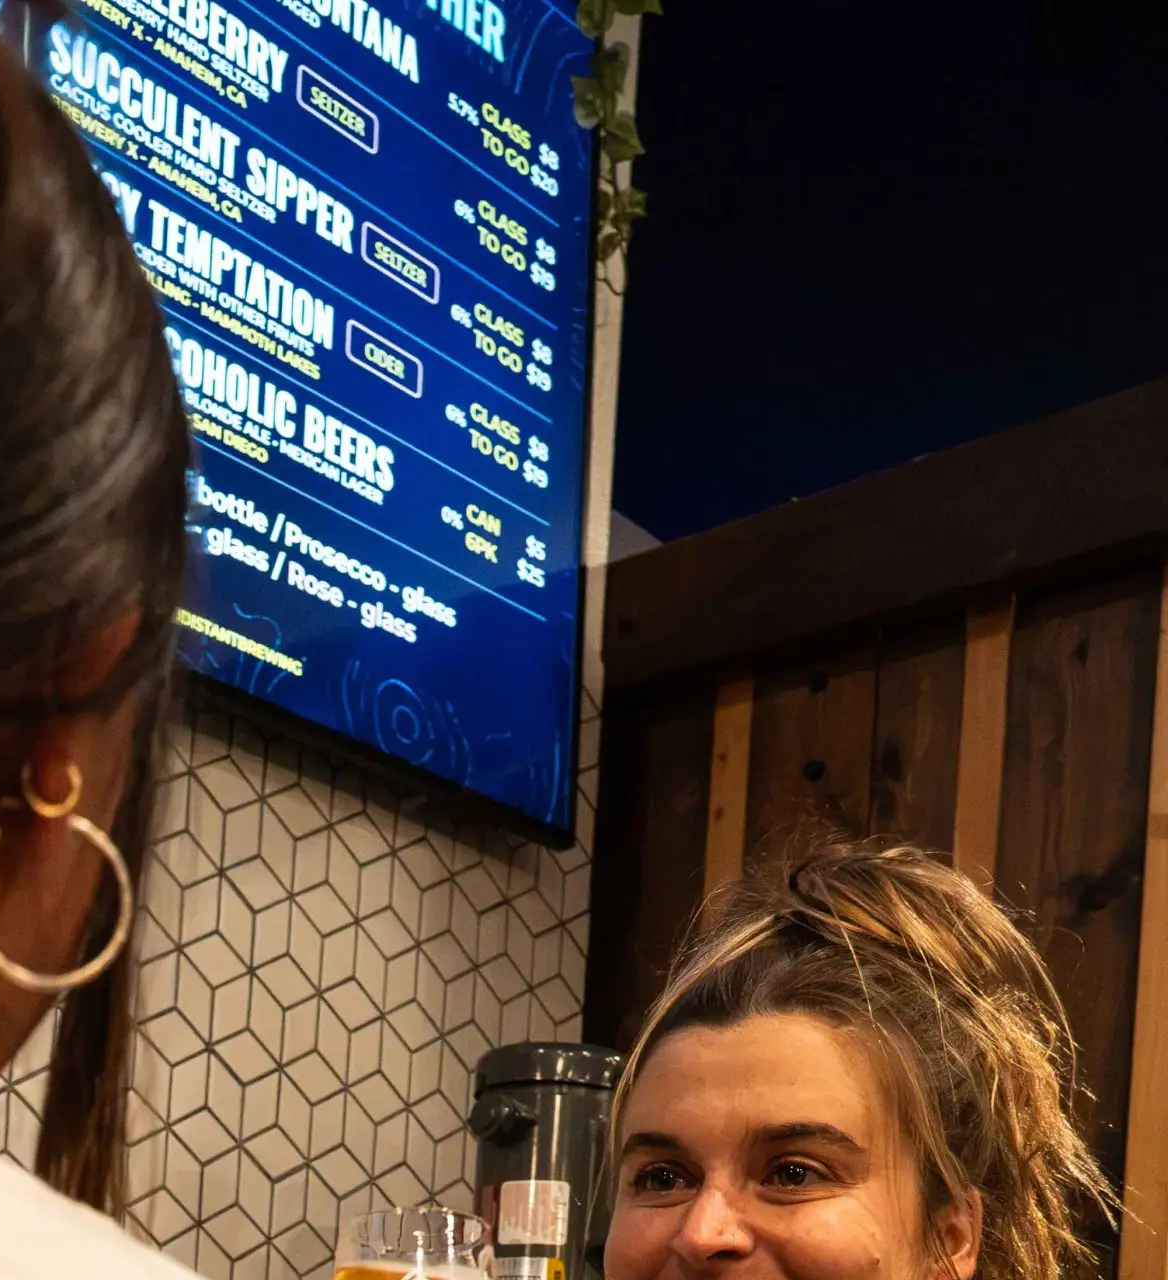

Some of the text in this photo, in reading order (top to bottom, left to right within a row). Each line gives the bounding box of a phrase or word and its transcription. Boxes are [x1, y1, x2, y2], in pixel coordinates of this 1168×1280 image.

[132, 21, 145, 41] X
[225, 84, 248, 109] CA
[167, 24, 210, 61] HARD
[211, 53, 270, 103] SELTZER
[310, 86, 366, 137] SELTZER
[481, 102, 532, 150] GLASS
[49, 23, 427, 288] SUCCULENT SIPPER SELTZER
[50, 74, 277, 224] CACTUS COOLER HARD SELTZER
[126, 140, 139, 160] X
[221, 199, 243, 223] CA
[480, 128, 559, 196] TO GO $20
[477, 225, 501, 254] TO
[501, 244, 527, 271] GO
[478, 200, 528, 246] GLASS
[133, 242, 315, 357] CIDER WITH OTHER FRUITS
[148, 199, 334, 350] TEMPTATION
[364, 343, 406, 379] CIDER
[200, 302, 277, 355] MAMMOTH
[277, 345, 321, 380] LAKES
[473, 303, 525, 347] GLASS
[473, 329, 497, 356] TO
[497, 346, 523, 373] GO
[184, 388, 384, 505] BLONDE ALE MEXICAN LAGER
[192, 413, 269, 463] SAN DIEGO
[304, 403, 395, 492] BEERS
[468, 428, 493, 456] TO
[493, 444, 519, 471] GO
[469, 402, 521, 445] GLASS
[198, 476, 269, 533] bottle
[284, 522, 387, 591] Prosecco
[402, 586, 457, 627] glass
[465, 503, 501, 537] CAN
[465, 531, 498, 563] 6PK
[206, 527, 270, 572] glass
[288, 560, 344, 607] Rose
[360, 602, 417, 643] glass
[175, 607, 303, 677] DISTANTBREWING
